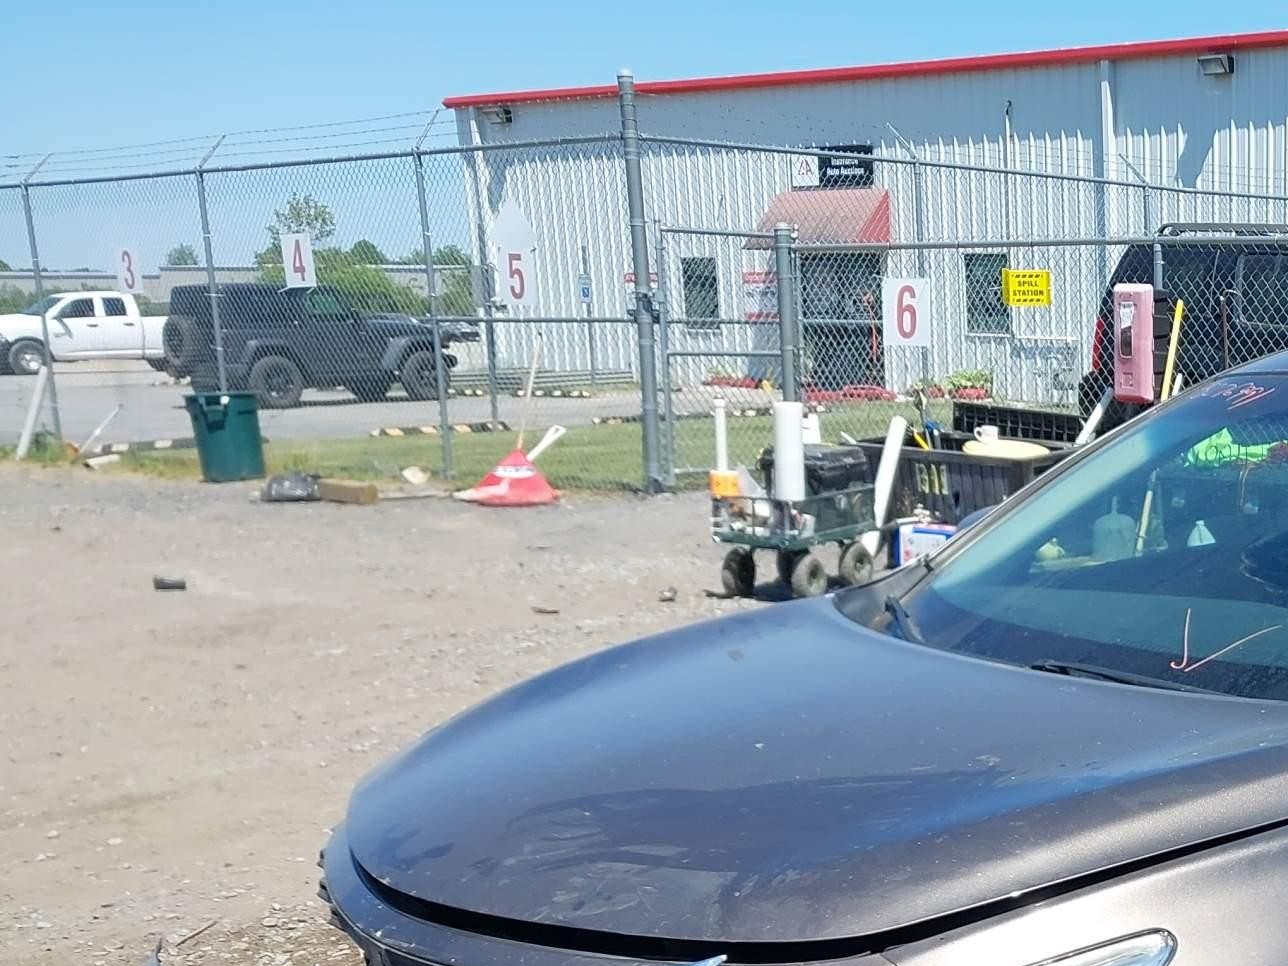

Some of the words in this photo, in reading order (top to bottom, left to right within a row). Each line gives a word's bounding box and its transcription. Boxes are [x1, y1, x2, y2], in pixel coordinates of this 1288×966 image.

[121, 250, 136, 289] 3
[293, 239, 306, 281] 4
[508, 253, 525, 299] 5
[896, 284, 917, 339] 6
